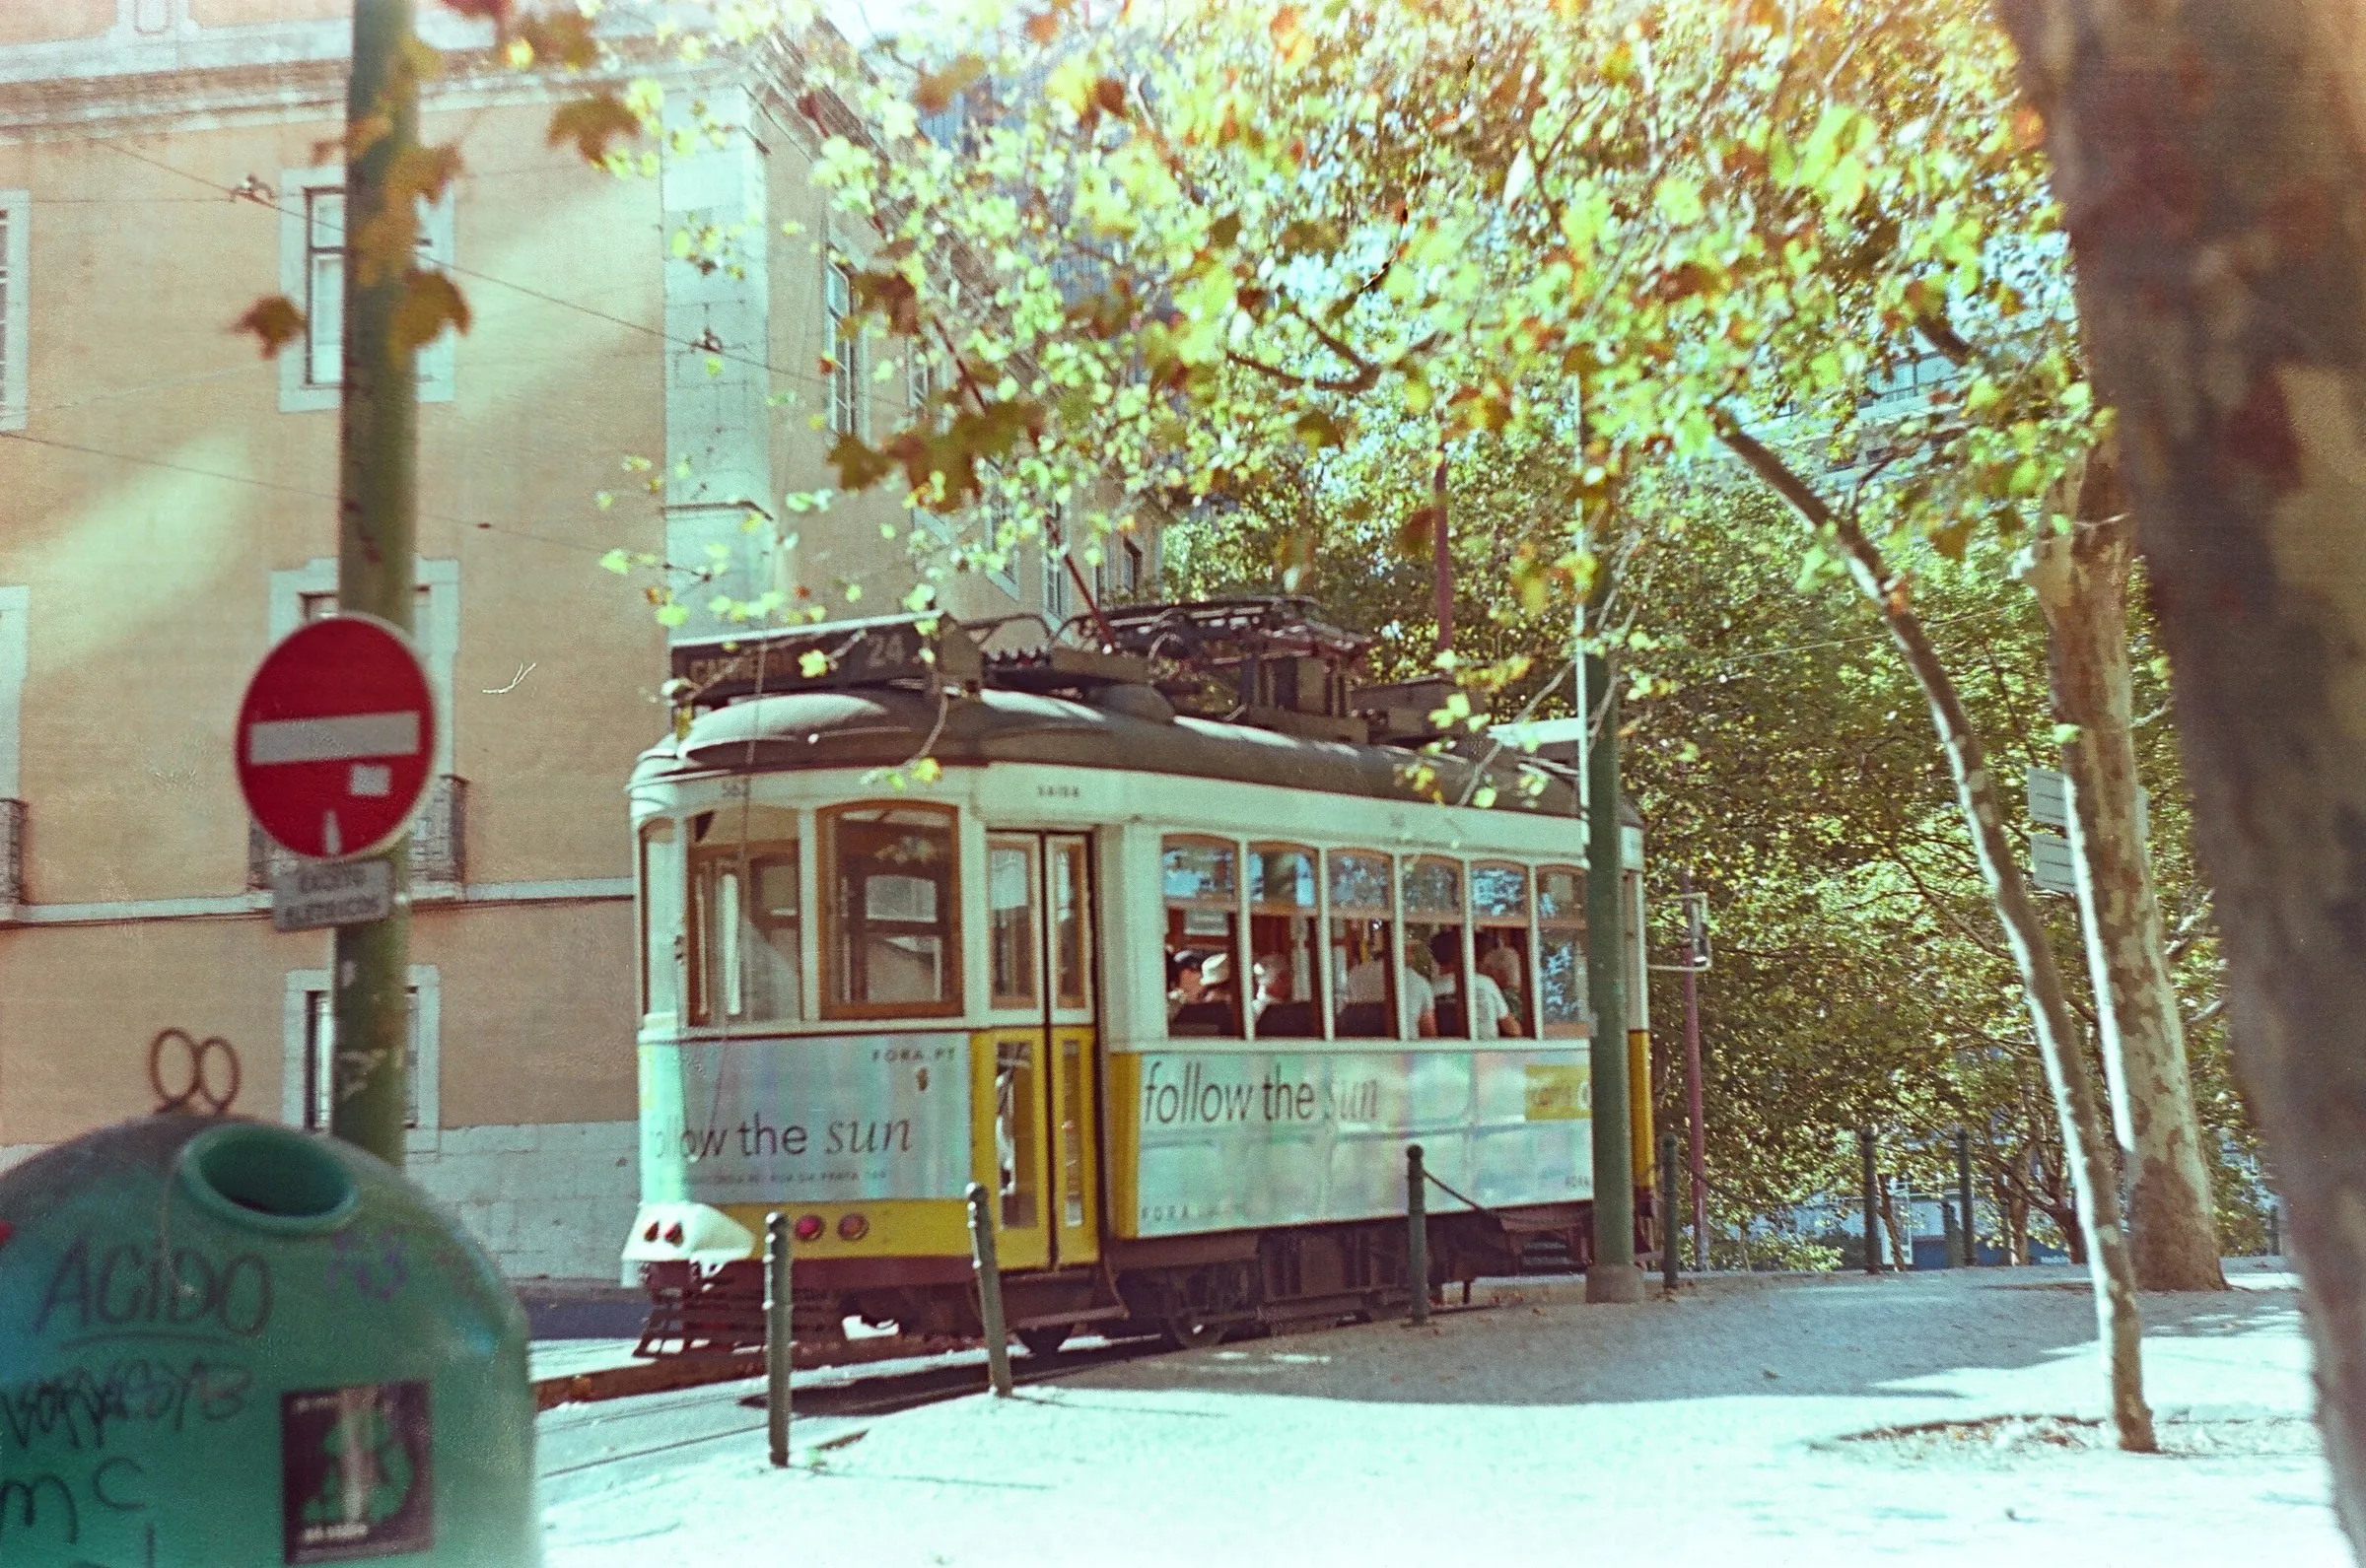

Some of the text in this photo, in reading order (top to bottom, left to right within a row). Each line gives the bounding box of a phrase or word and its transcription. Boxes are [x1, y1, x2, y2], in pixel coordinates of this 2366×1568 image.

[866, 634, 907, 668] 24
[1144, 1060, 1253, 1124] follow
[1262, 1062, 1314, 1122] the
[736, 1111, 807, 1157] the
[825, 1118, 912, 1157] sun
